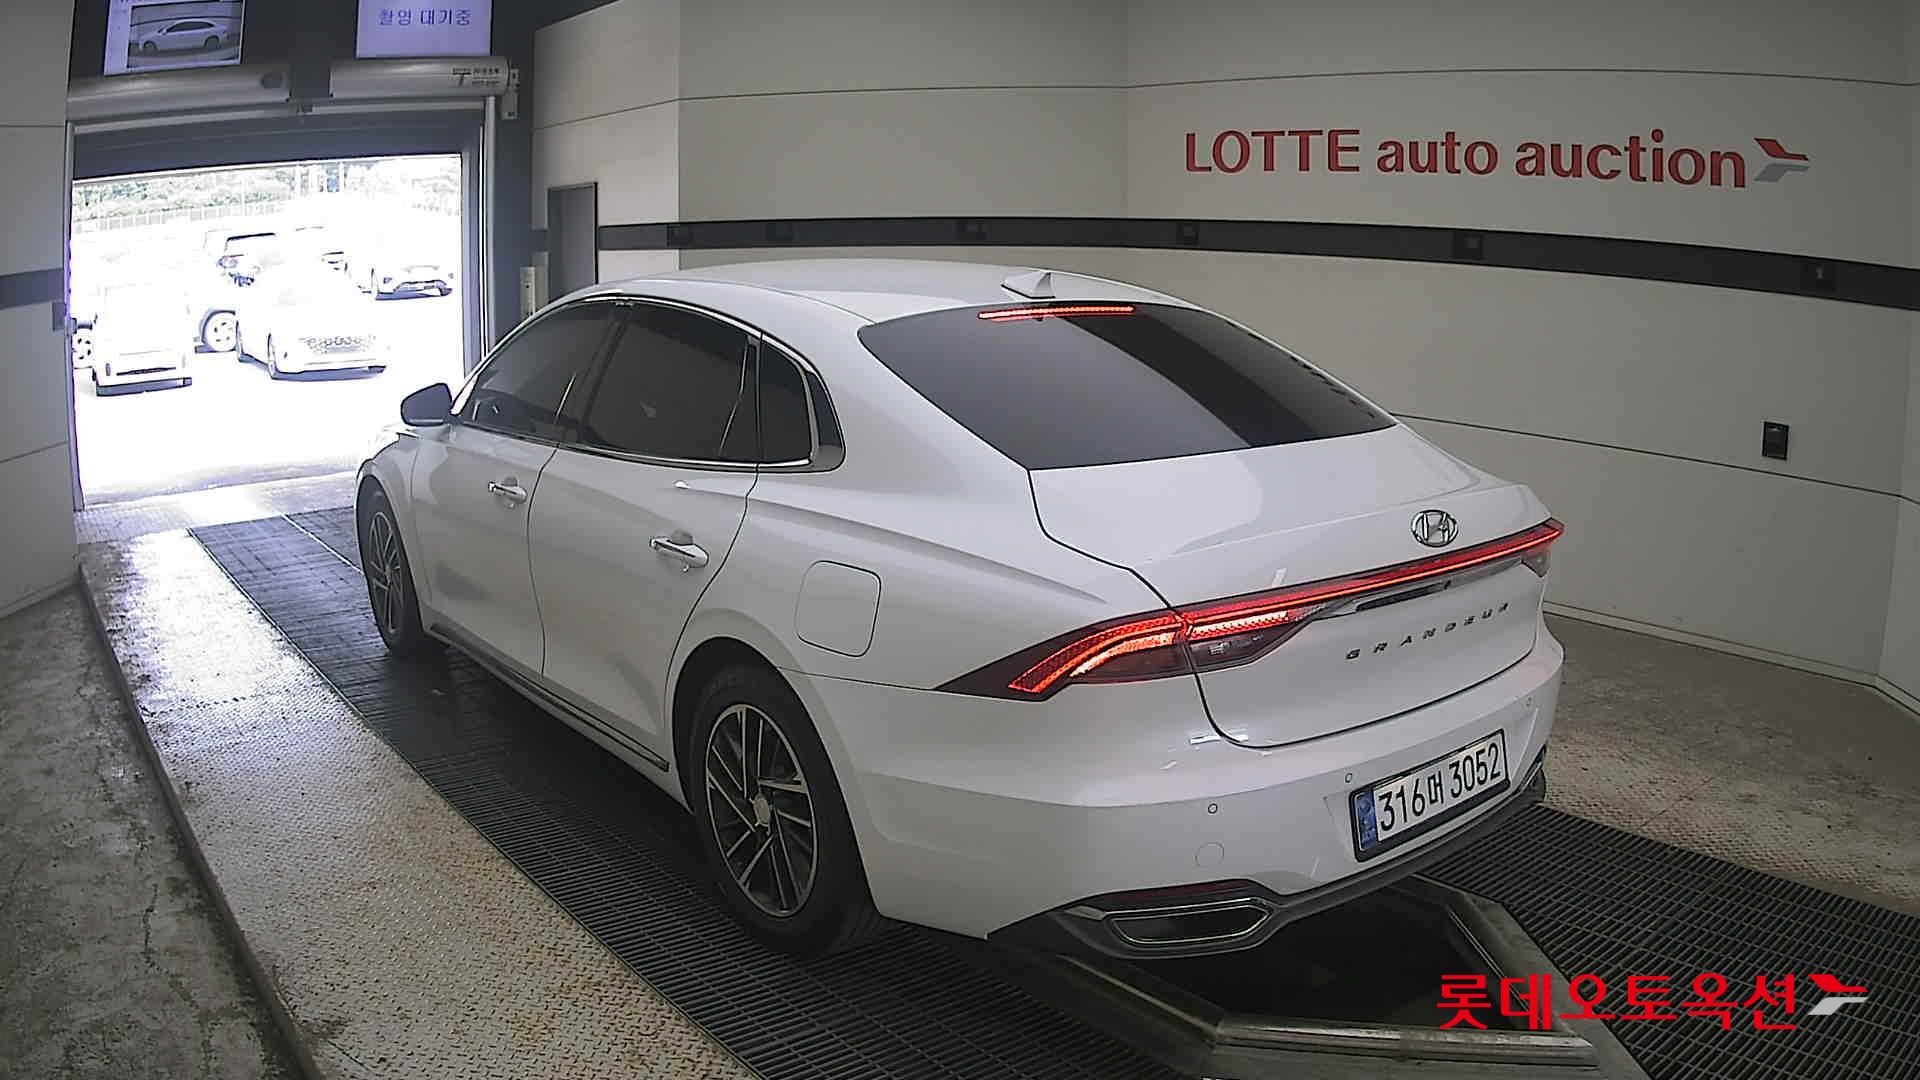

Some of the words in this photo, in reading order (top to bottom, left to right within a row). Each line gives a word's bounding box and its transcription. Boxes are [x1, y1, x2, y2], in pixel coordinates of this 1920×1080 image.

[420, 8, 472, 26] 대기중
[1185, 129, 1361, 173] LOTTE
[1377, 131, 1500, 175] auto
[1515, 129, 1746, 188] auction
[1346, 602, 1508, 660] GRANDEUR
[1448, 742, 1501, 799] 3052
